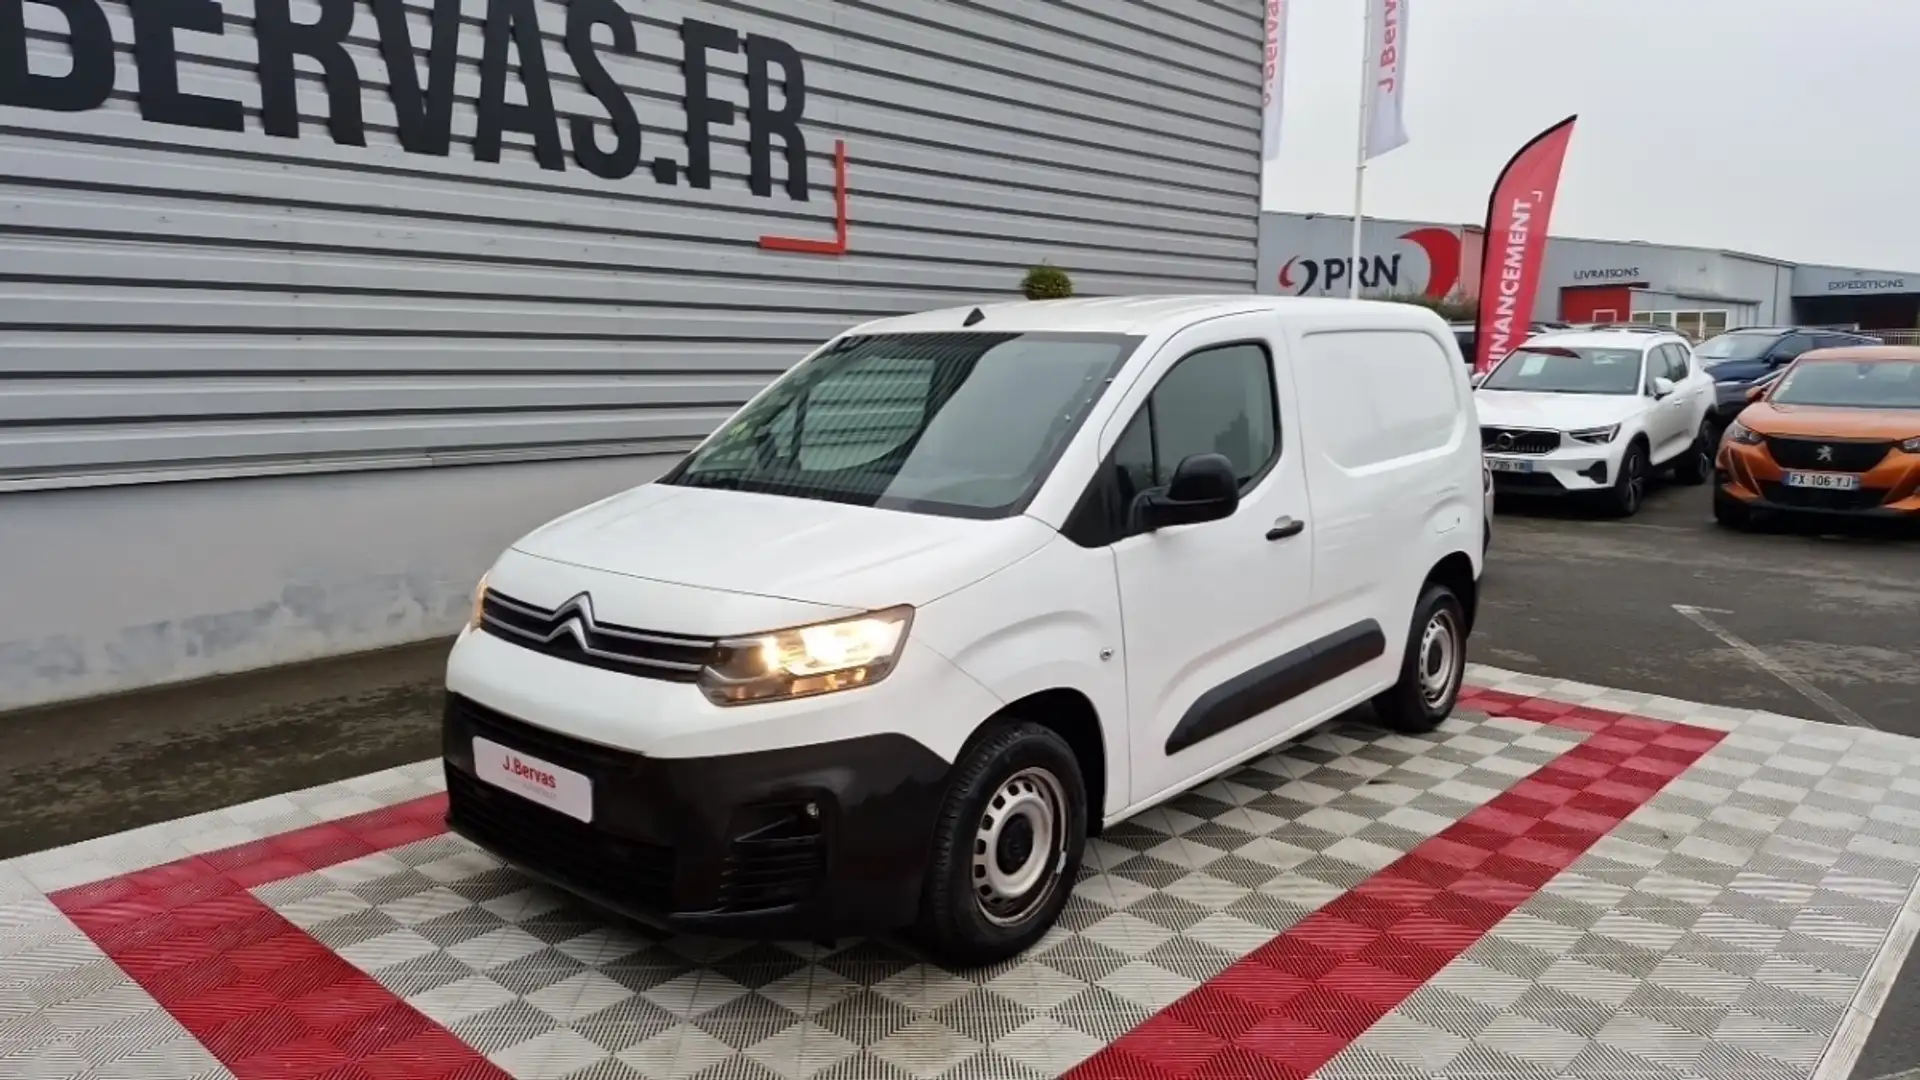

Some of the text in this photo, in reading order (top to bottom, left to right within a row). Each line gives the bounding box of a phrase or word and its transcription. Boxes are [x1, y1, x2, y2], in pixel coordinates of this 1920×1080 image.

[1323, 254, 1402, 290] PRN
[1487, 199, 1532, 372] FINANCEMENT
[1573, 267, 1640, 280] LIVRAISONS
[1828, 279, 1904, 290] EXPEDITIONS
[502, 755, 557, 789] J.Bervas
